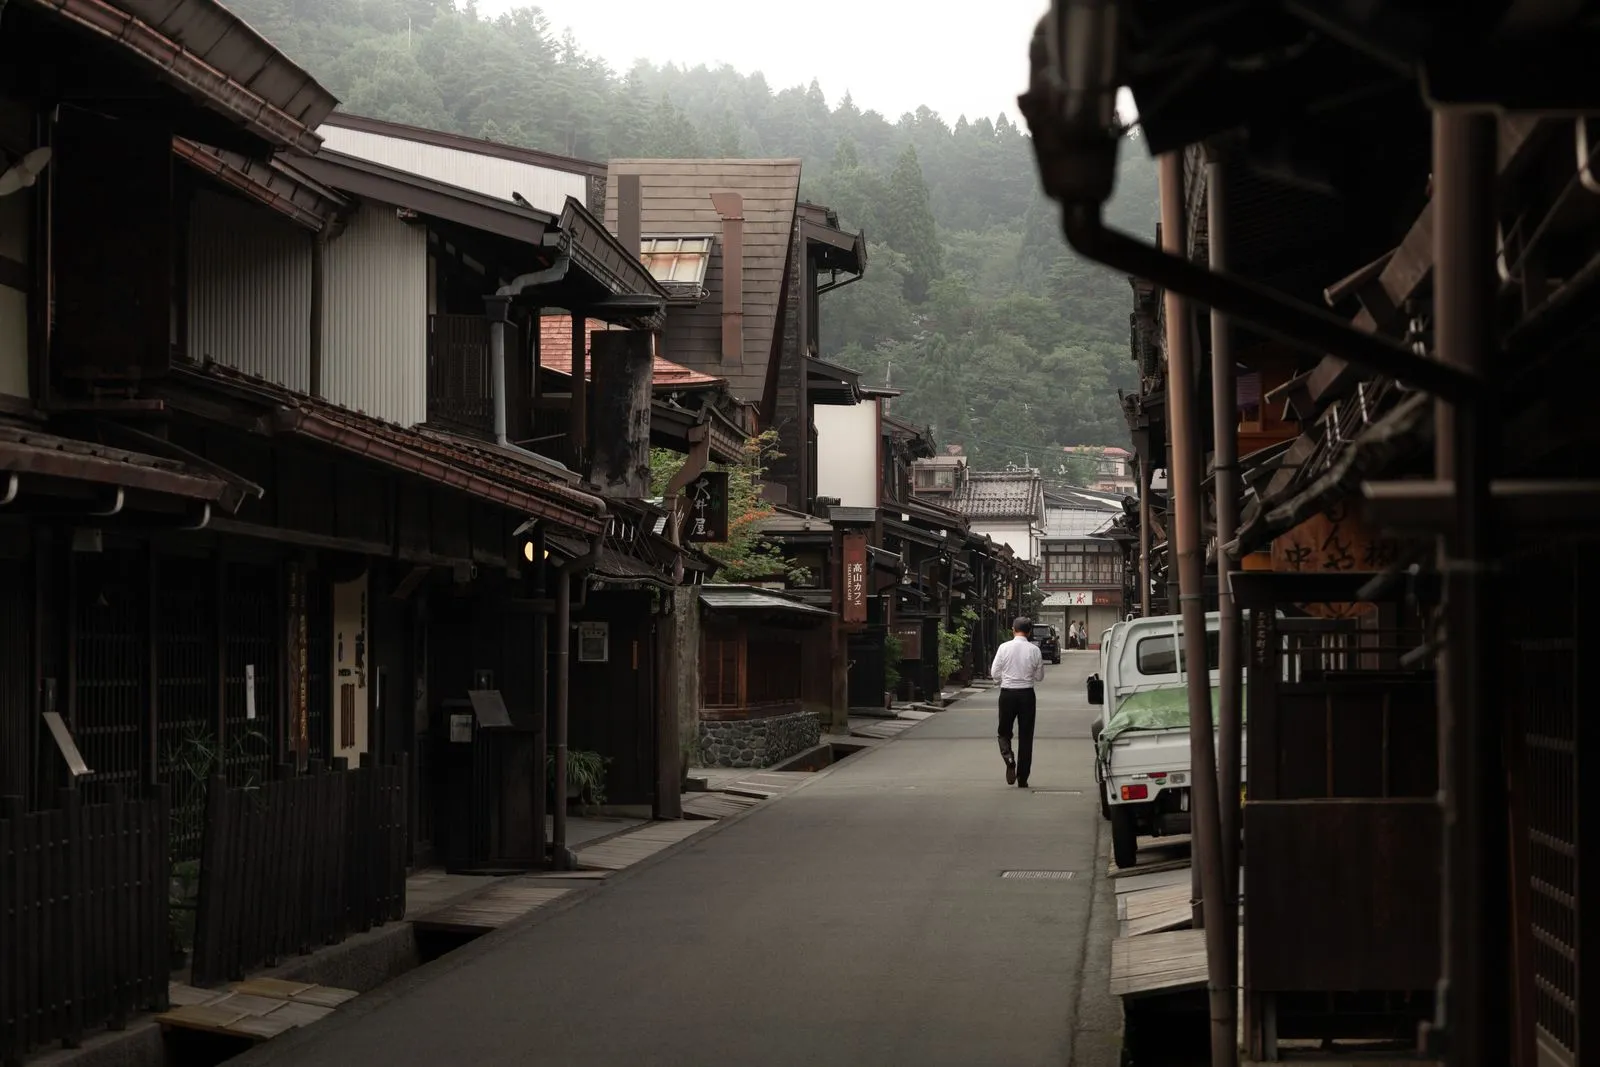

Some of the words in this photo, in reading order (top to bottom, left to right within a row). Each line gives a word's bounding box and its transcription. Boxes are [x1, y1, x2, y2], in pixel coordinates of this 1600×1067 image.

[853, 563, 862, 606] 高山カフェ
